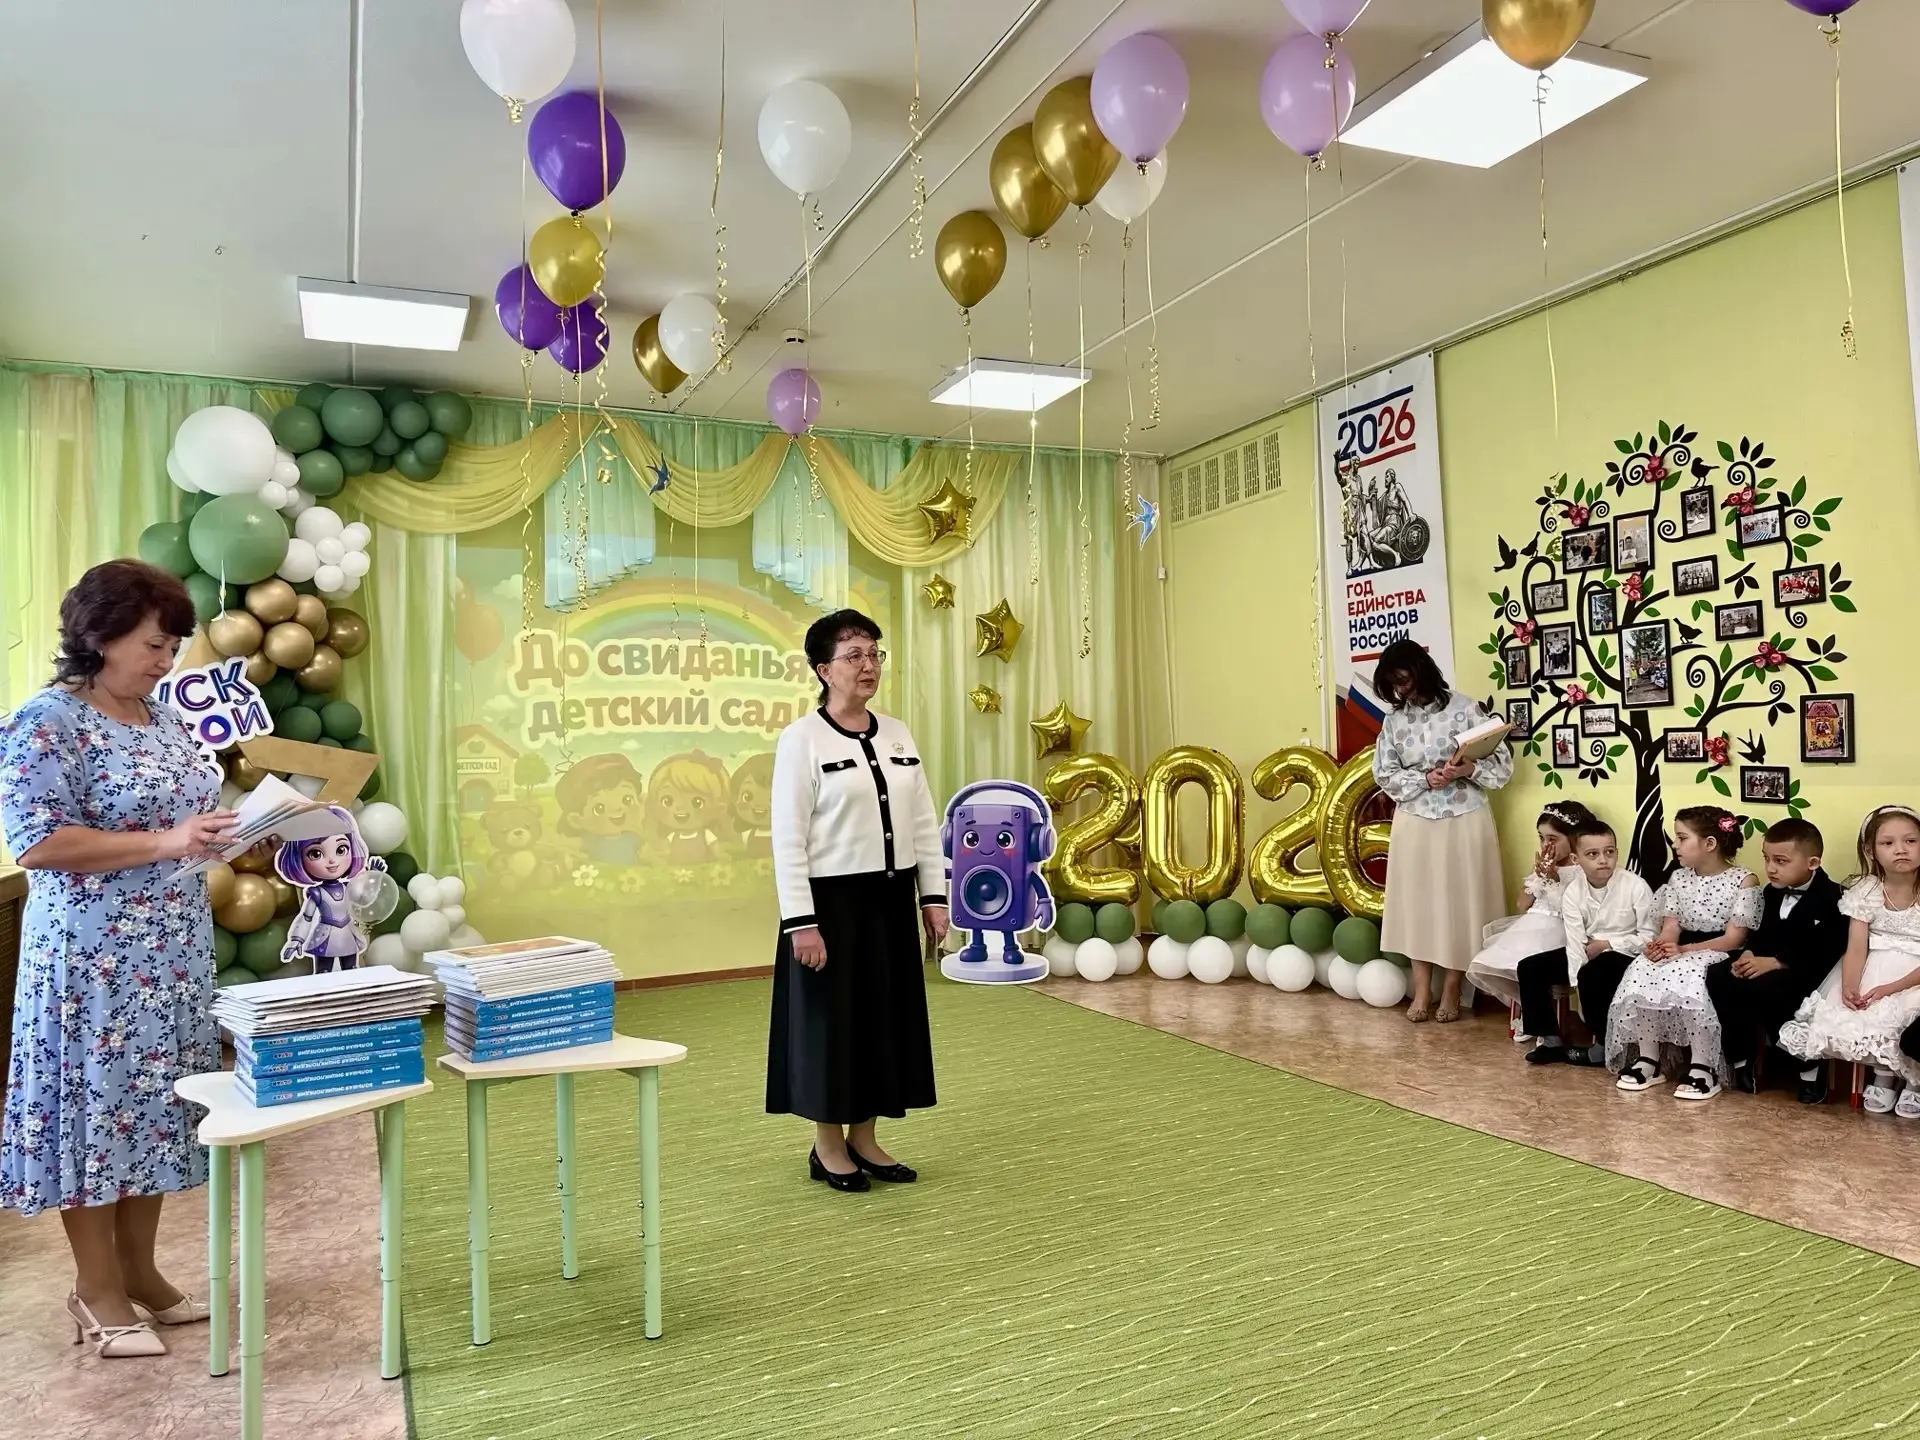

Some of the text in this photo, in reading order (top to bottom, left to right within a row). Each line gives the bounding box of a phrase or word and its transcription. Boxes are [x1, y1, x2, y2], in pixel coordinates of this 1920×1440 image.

[1338, 398, 1416, 461] 2026
[1346, 580, 1374, 599] ГОД
[1347, 588, 1427, 617] ЕДИНСТВА
[1349, 608, 1419, 634] НАРОДОВ
[1350, 628, 1410, 651] РОССИИ
[515, 634, 589, 690] До
[527, 689, 710, 742] детский
